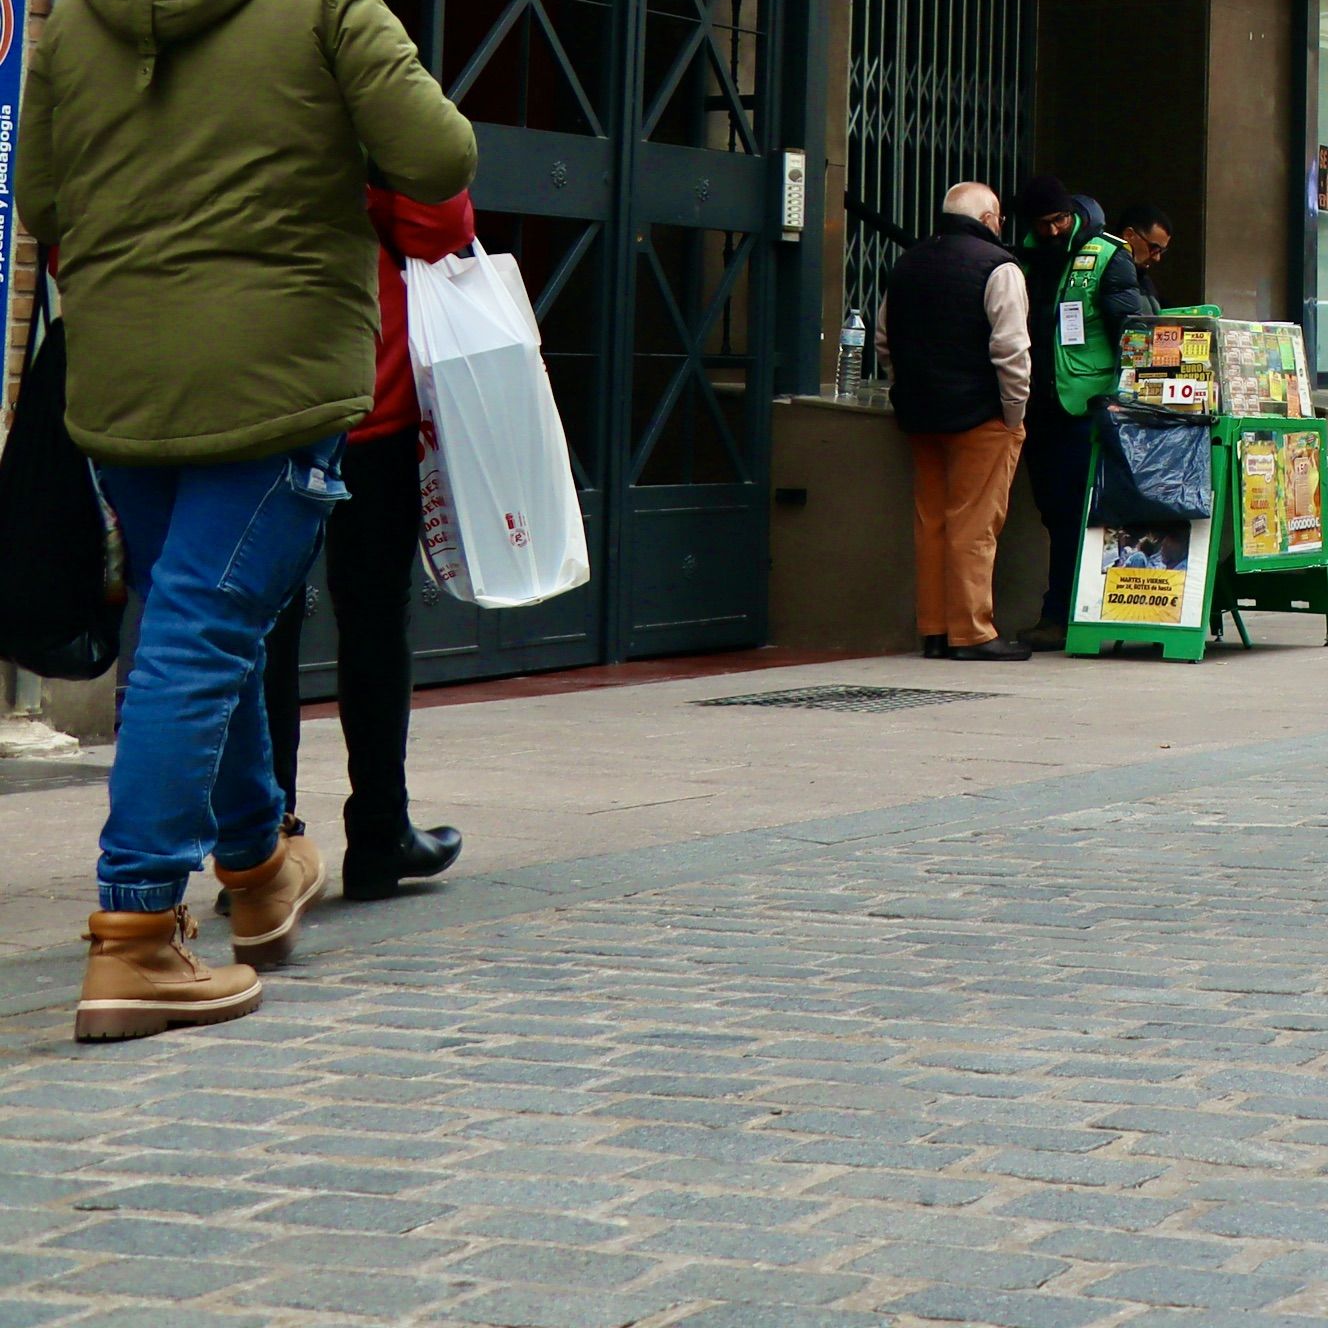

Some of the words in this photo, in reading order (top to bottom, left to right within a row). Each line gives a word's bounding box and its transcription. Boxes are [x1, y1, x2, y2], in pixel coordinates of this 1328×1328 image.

[1156, 330, 1178, 342] x50
[1120, 576, 1141, 584] MARTES
[1107, 593, 1168, 606] 120.000.000
[1170, 596, 1178, 607] €
